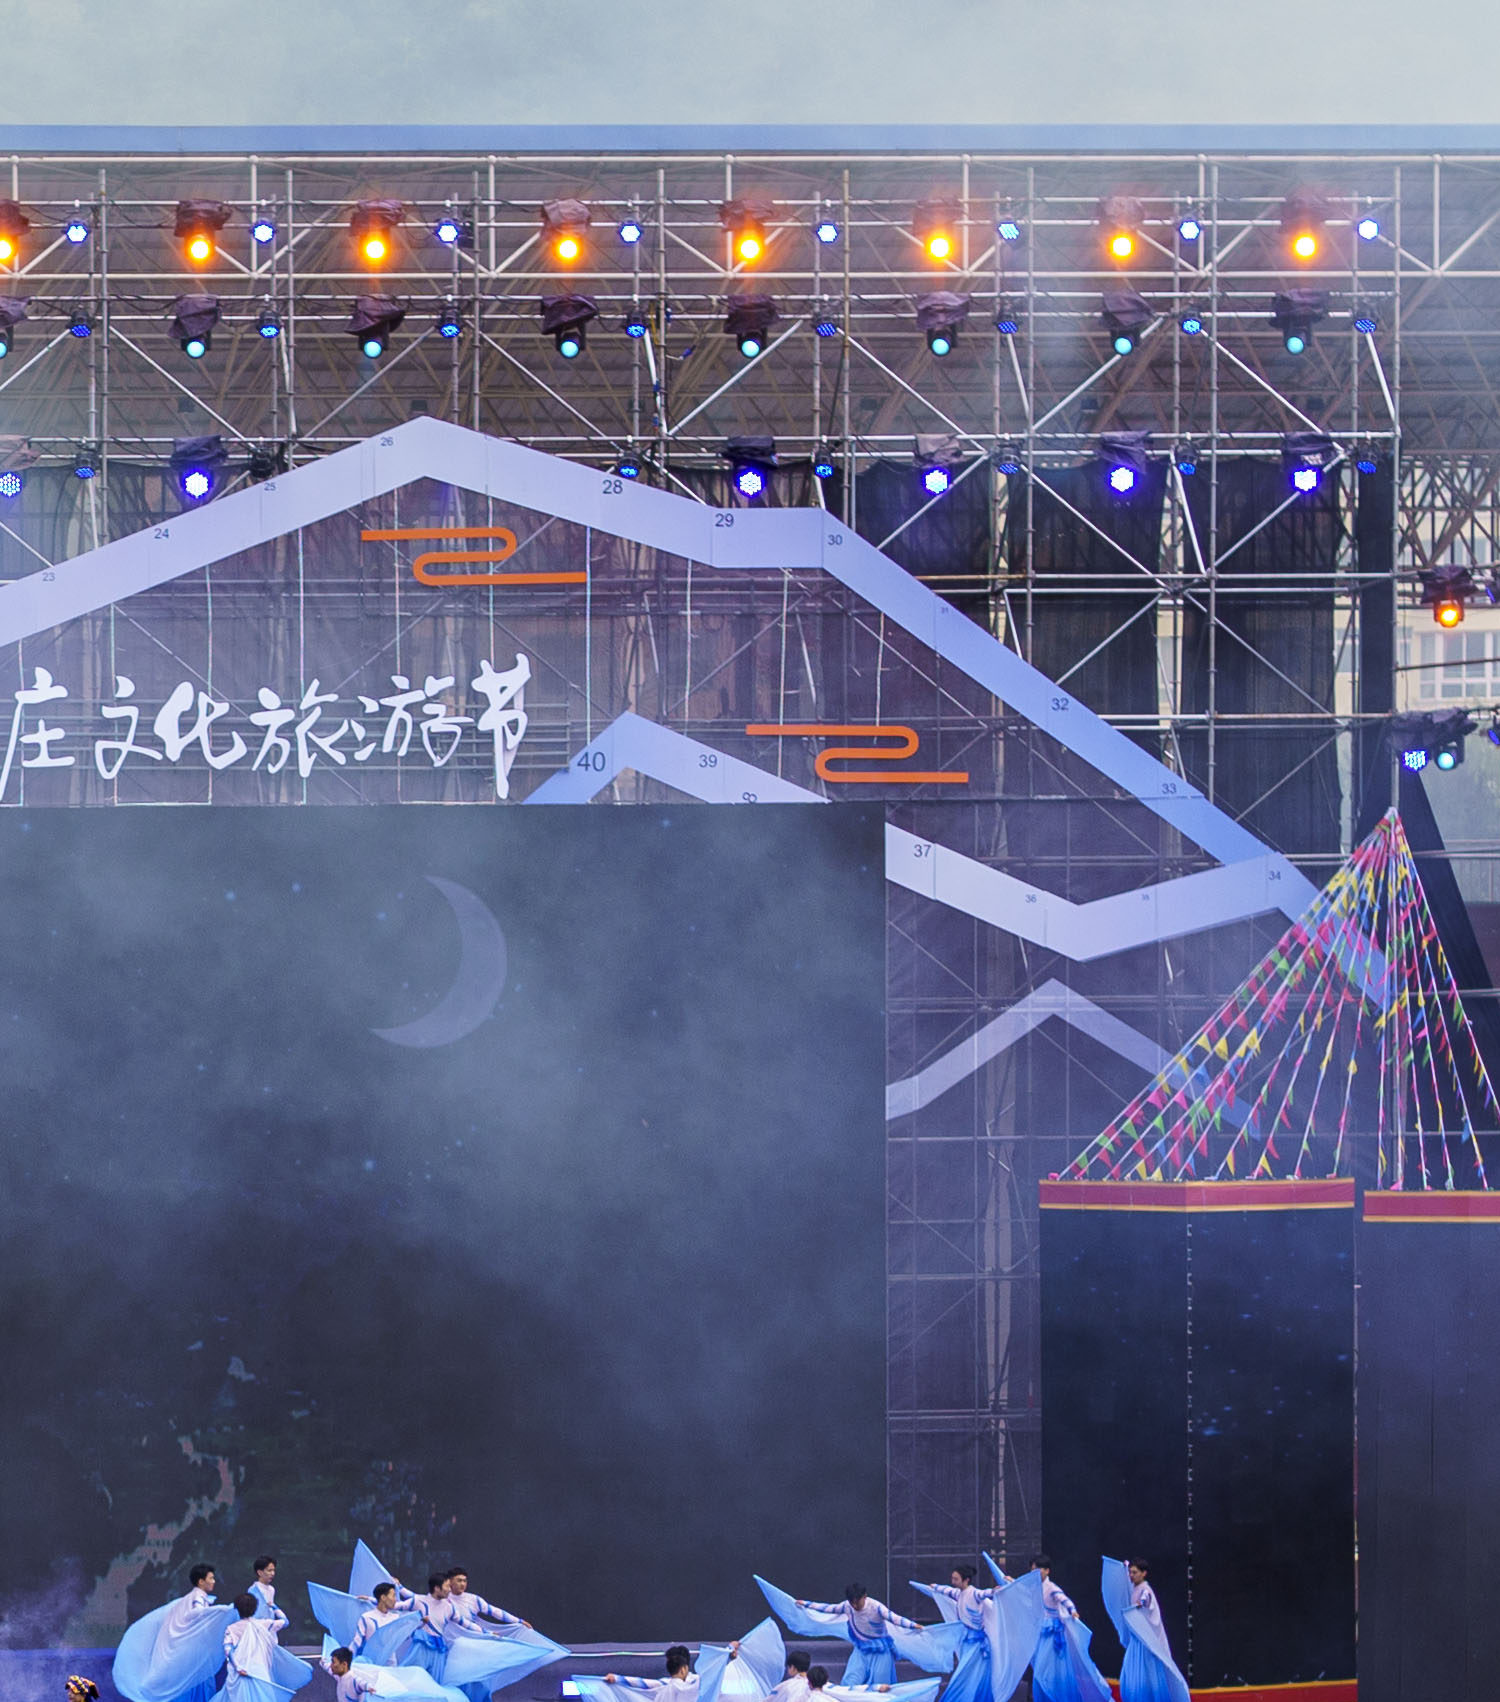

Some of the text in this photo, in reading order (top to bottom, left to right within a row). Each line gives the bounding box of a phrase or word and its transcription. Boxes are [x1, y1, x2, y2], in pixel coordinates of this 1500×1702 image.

[380, 436, 394, 447] 26
[263, 482, 276, 491] 25
[602, 479, 623, 494] 28
[715, 513, 734, 527] 29
[154, 527, 169, 539] 24
[828, 534, 843, 546] 30
[42, 572, 55, 582] 23
[1051, 697, 1069, 711] 32
[577, 751, 606, 772] 40
[698, 754, 717, 768] 39
[1161, 783, 1177, 795] 33
[913, 844, 932, 858] 37
[1268, 871, 1281, 881] 34
[1025, 894, 1037, 904] 36
